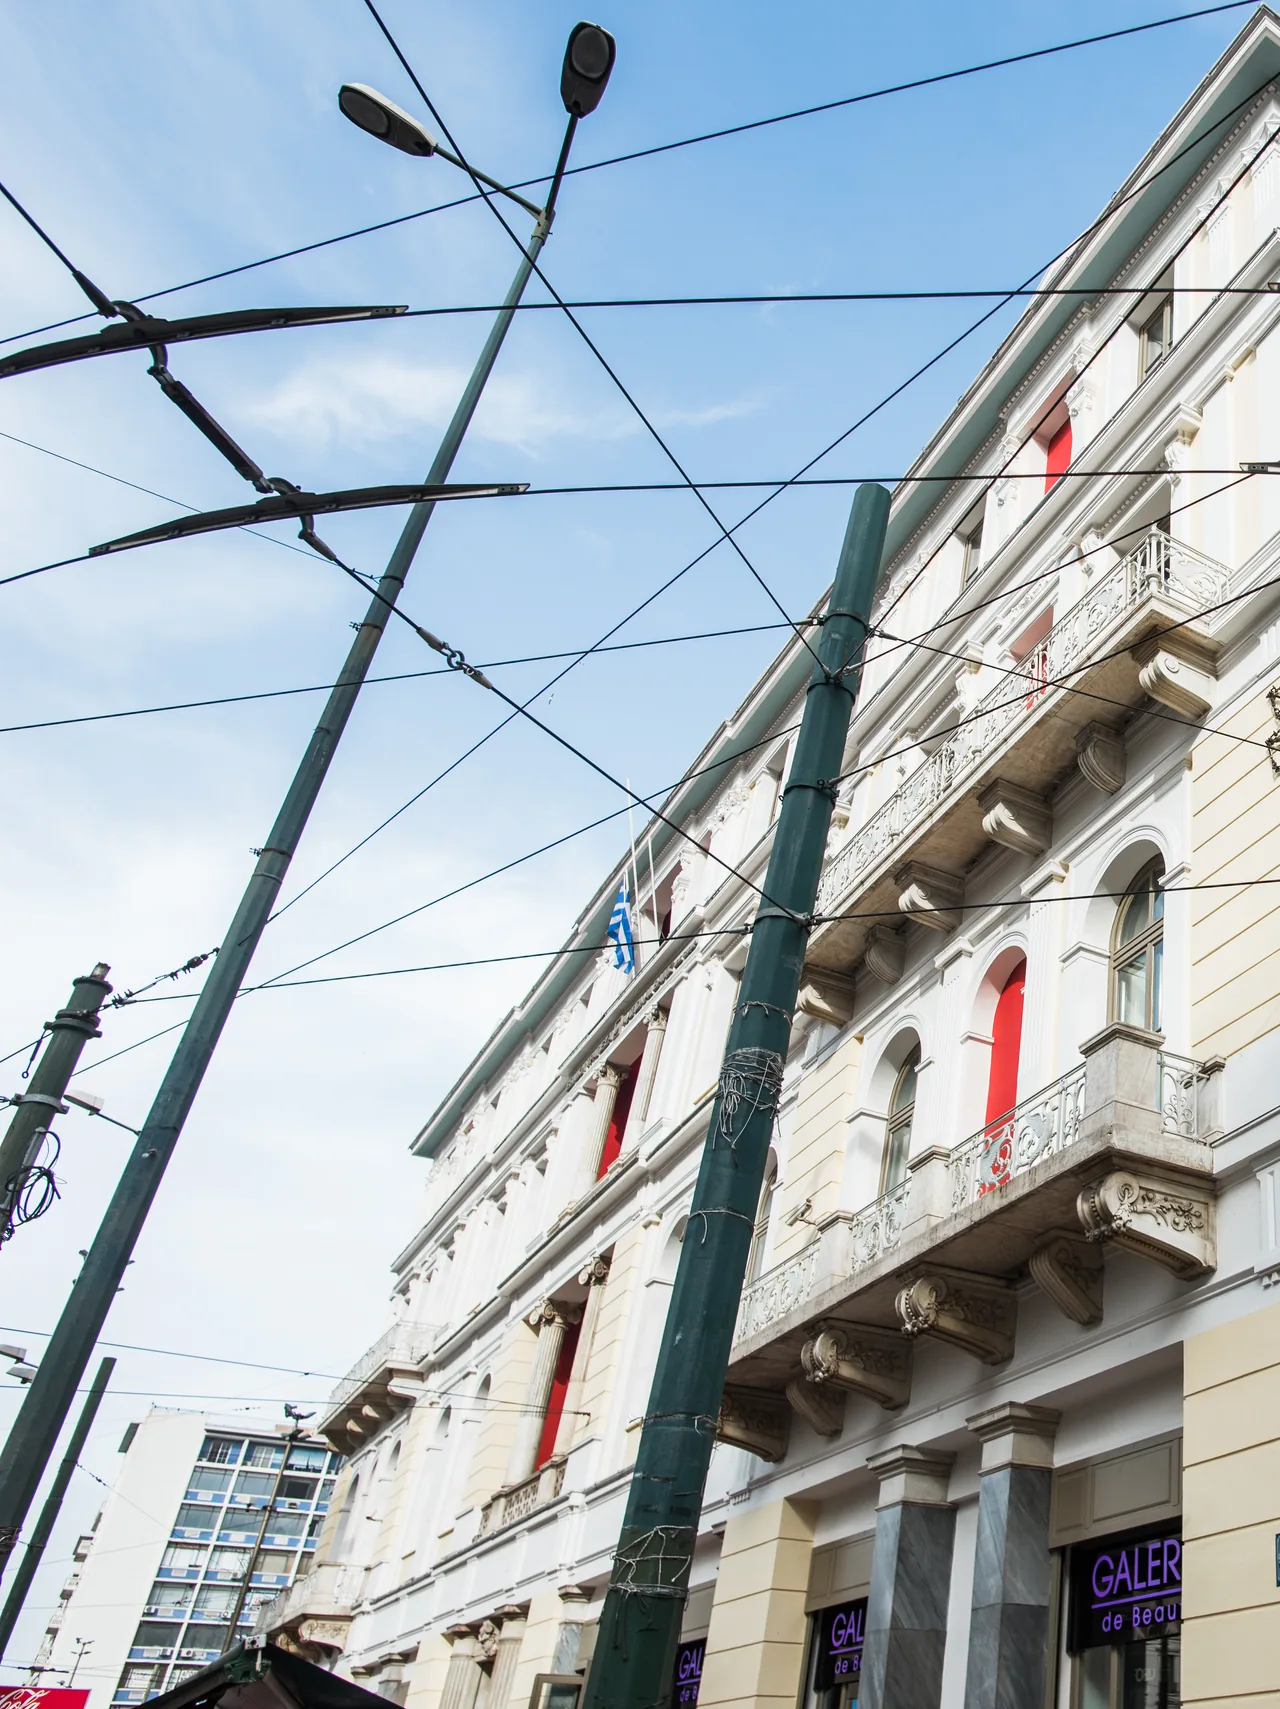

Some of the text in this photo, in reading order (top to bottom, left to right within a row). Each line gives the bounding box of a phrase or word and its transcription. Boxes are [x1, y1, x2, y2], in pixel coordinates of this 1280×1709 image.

[1102, 1602, 1182, 1633] de Beau
[834, 1659, 849, 1674] de
